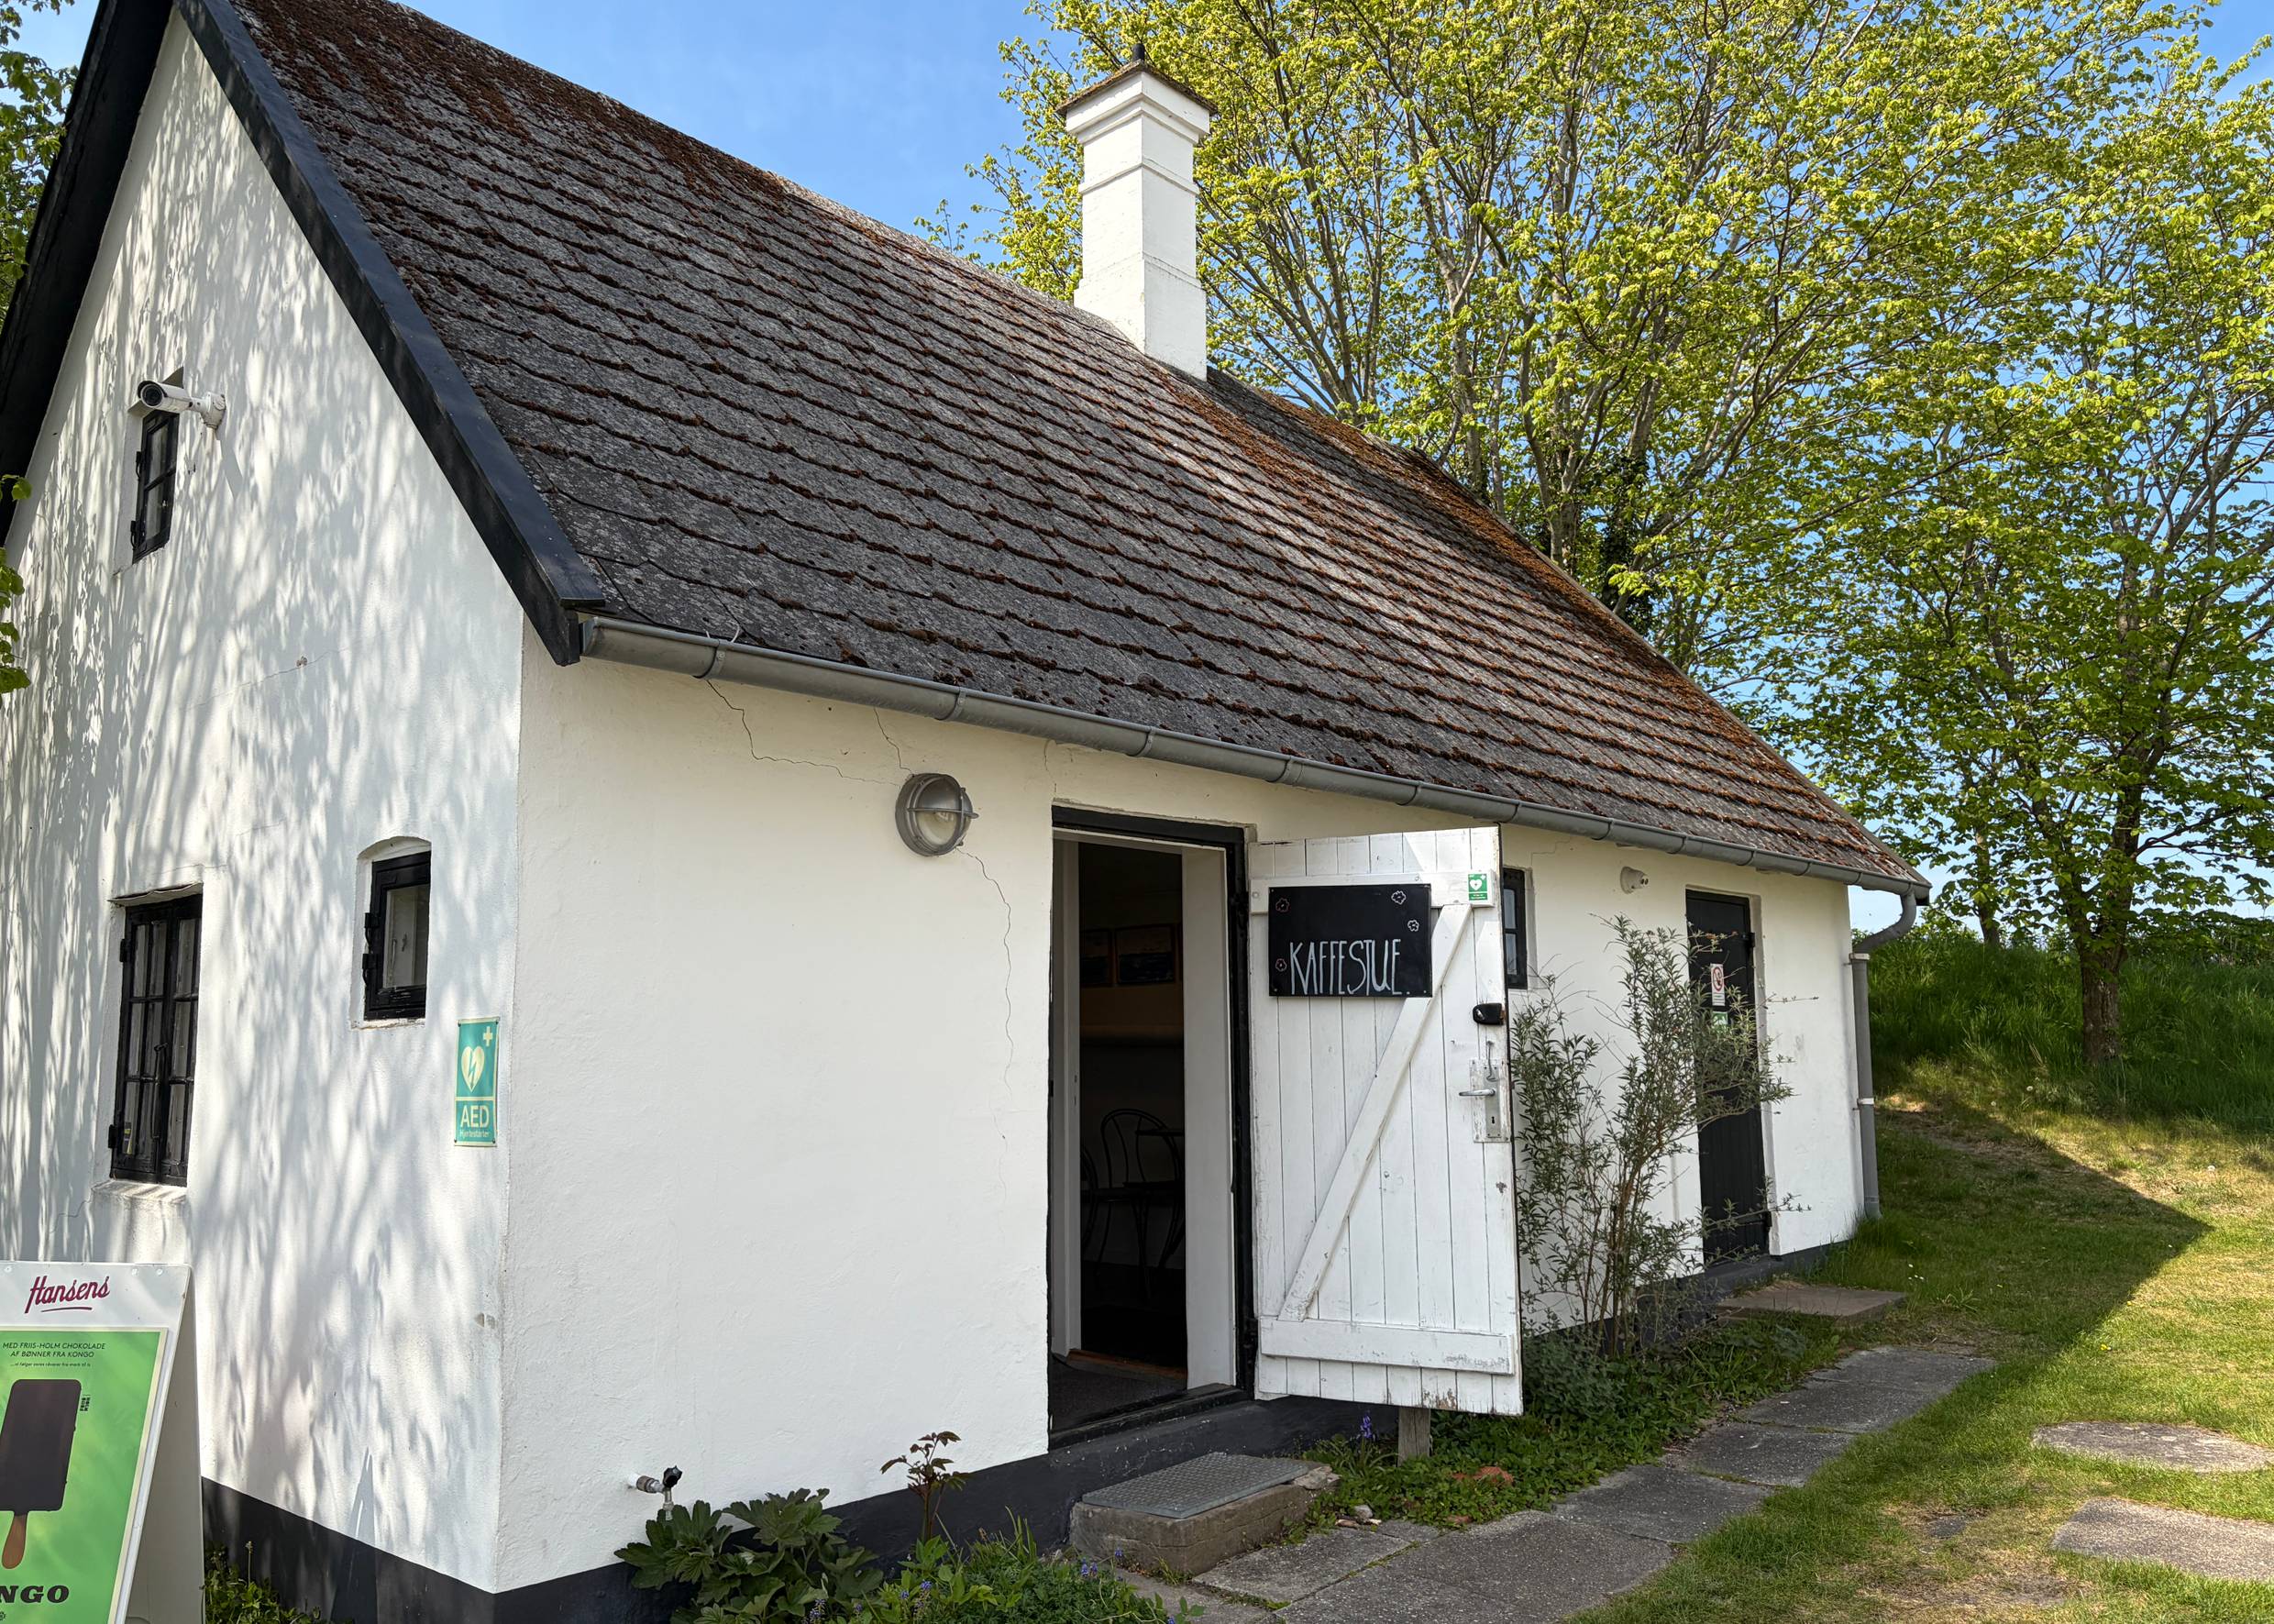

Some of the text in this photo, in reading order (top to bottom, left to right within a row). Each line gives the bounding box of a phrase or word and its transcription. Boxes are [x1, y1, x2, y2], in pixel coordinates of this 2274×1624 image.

[460, 1105, 490, 1128] AED
[25, 1276, 110, 1314] Hansens
[19, 1342, 61, 1350] FRIIS-HOLM
